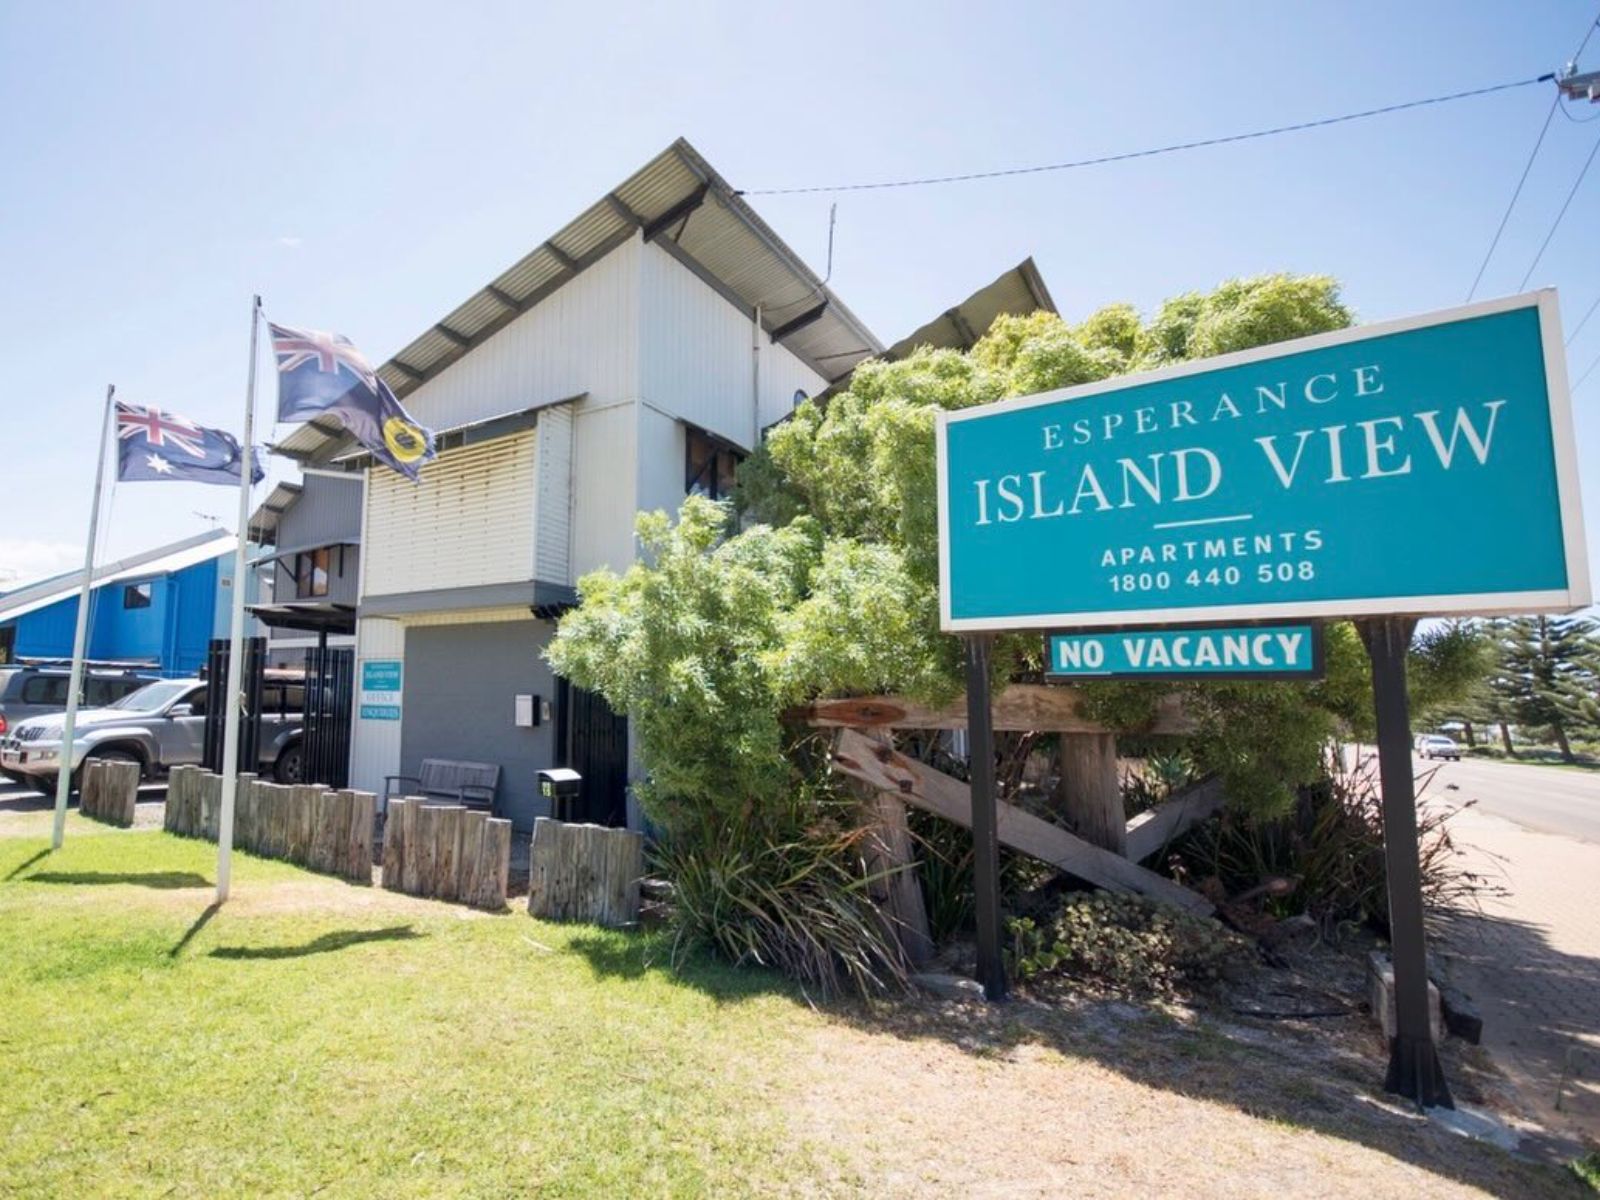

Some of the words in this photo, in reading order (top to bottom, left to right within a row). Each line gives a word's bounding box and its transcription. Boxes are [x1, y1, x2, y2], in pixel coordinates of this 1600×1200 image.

[1042, 364, 1386, 450] ESPERANCE
[974, 447, 1223, 526] ISLAND
[1254, 400, 1506, 489] VIEW
[1101, 530, 1325, 567] APARTMENTS
[1109, 573, 1171, 593] 1800
[1185, 566, 1241, 588] 440
[1257, 561, 1315, 583] 508
[1059, 639, 1105, 668] NO
[1122, 633, 1304, 668] VACANCY
